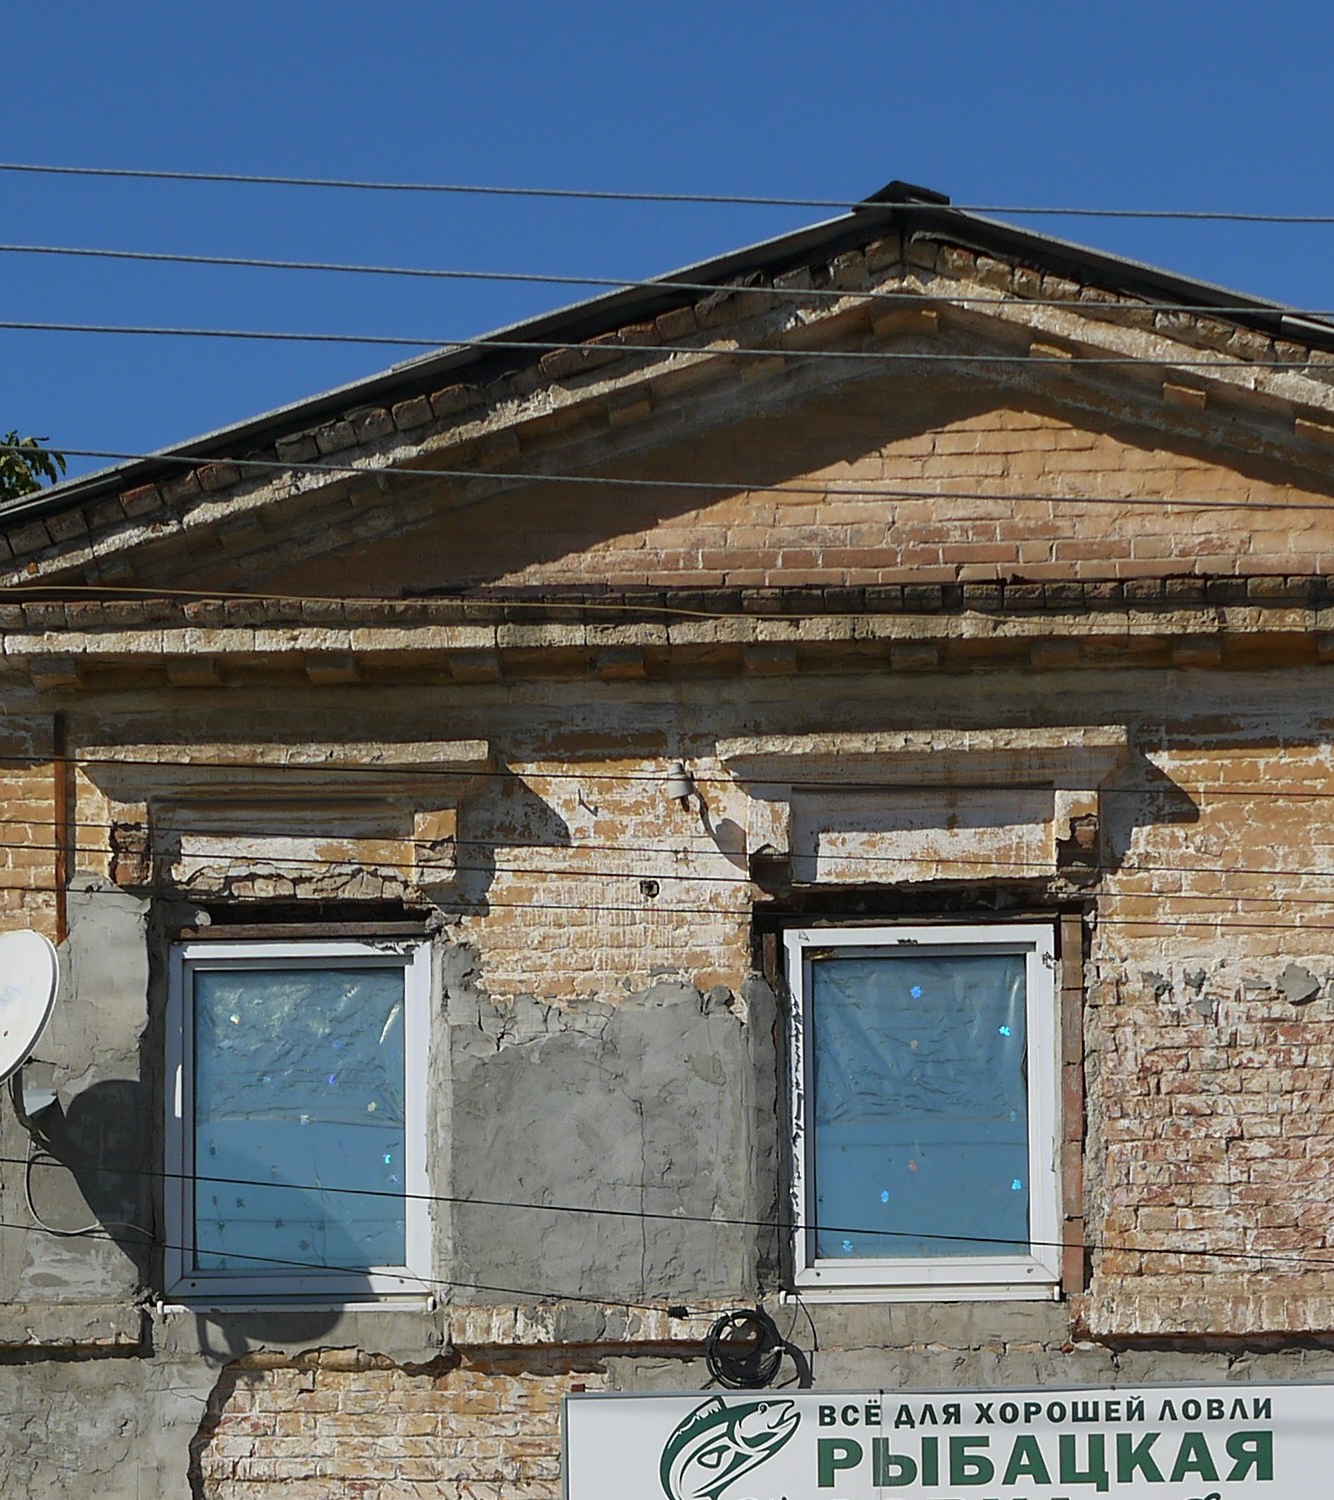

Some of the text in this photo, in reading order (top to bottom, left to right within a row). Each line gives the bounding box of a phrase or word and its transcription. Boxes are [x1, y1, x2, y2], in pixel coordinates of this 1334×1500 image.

[818, 1395, 1272, 1430] ВСЁ ДЛЯ ХОРОШЕЙ ЛОВЛИ
[817, 1431, 1274, 1493] РЫБАЦКАЯ
